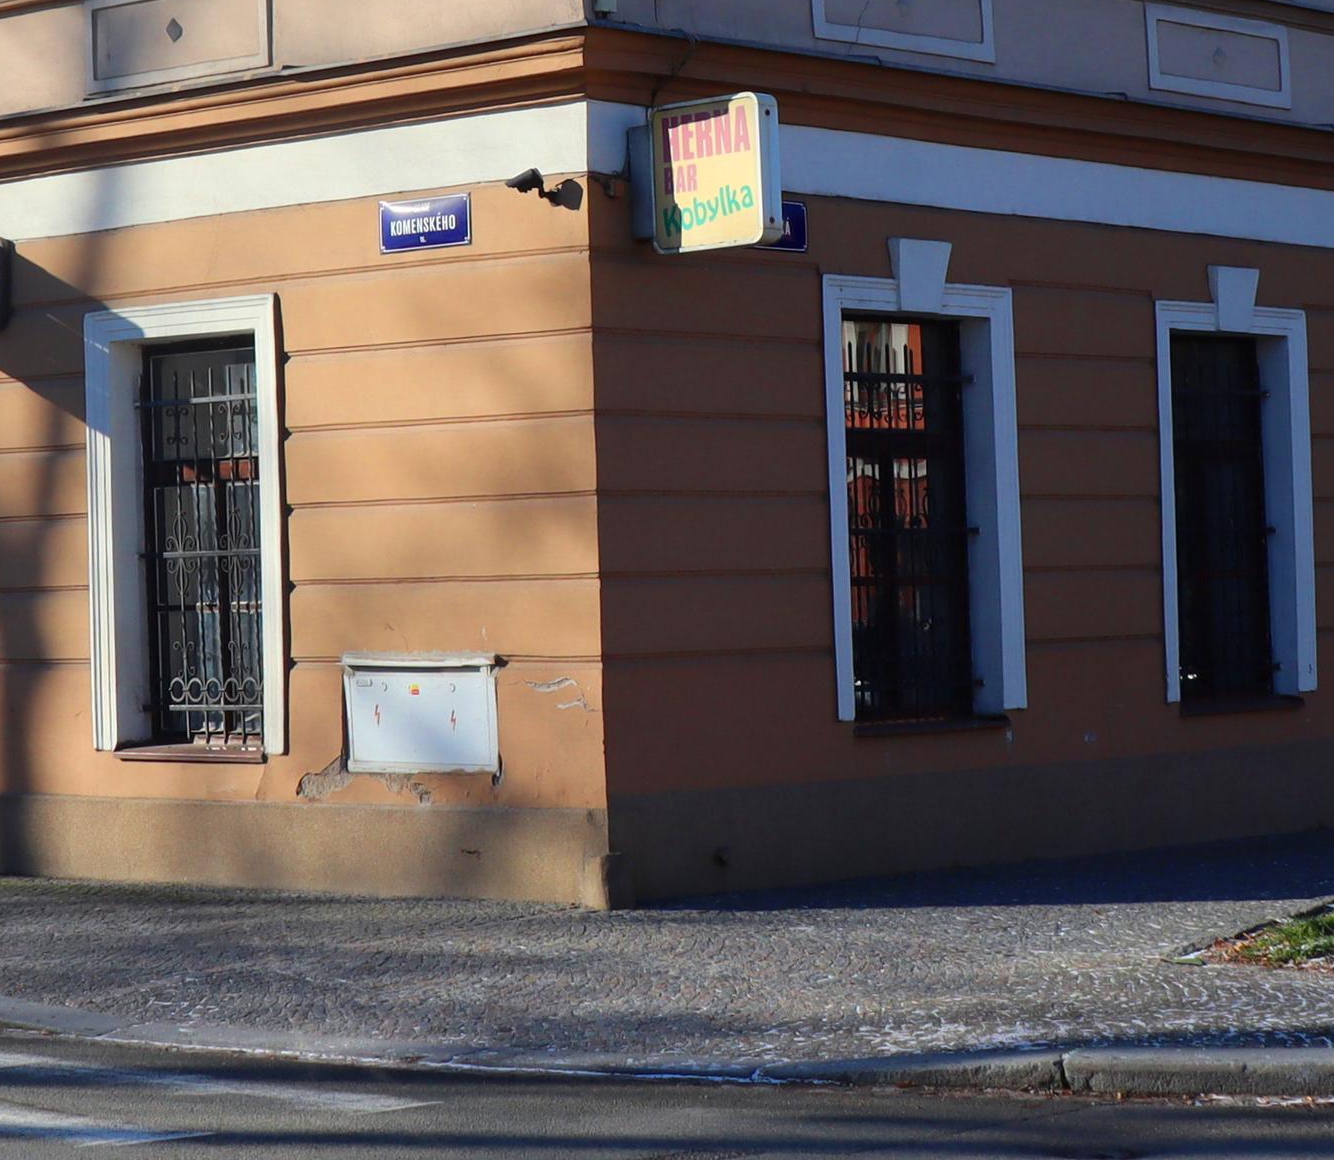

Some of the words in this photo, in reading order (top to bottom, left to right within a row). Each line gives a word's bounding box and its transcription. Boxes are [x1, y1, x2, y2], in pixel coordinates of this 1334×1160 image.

[661, 105, 751, 163] HERNA
[664, 163, 698, 195] BAR
[390, 212, 456, 236] KOMENSKÉHO
[663, 184, 754, 237] Kobylka
